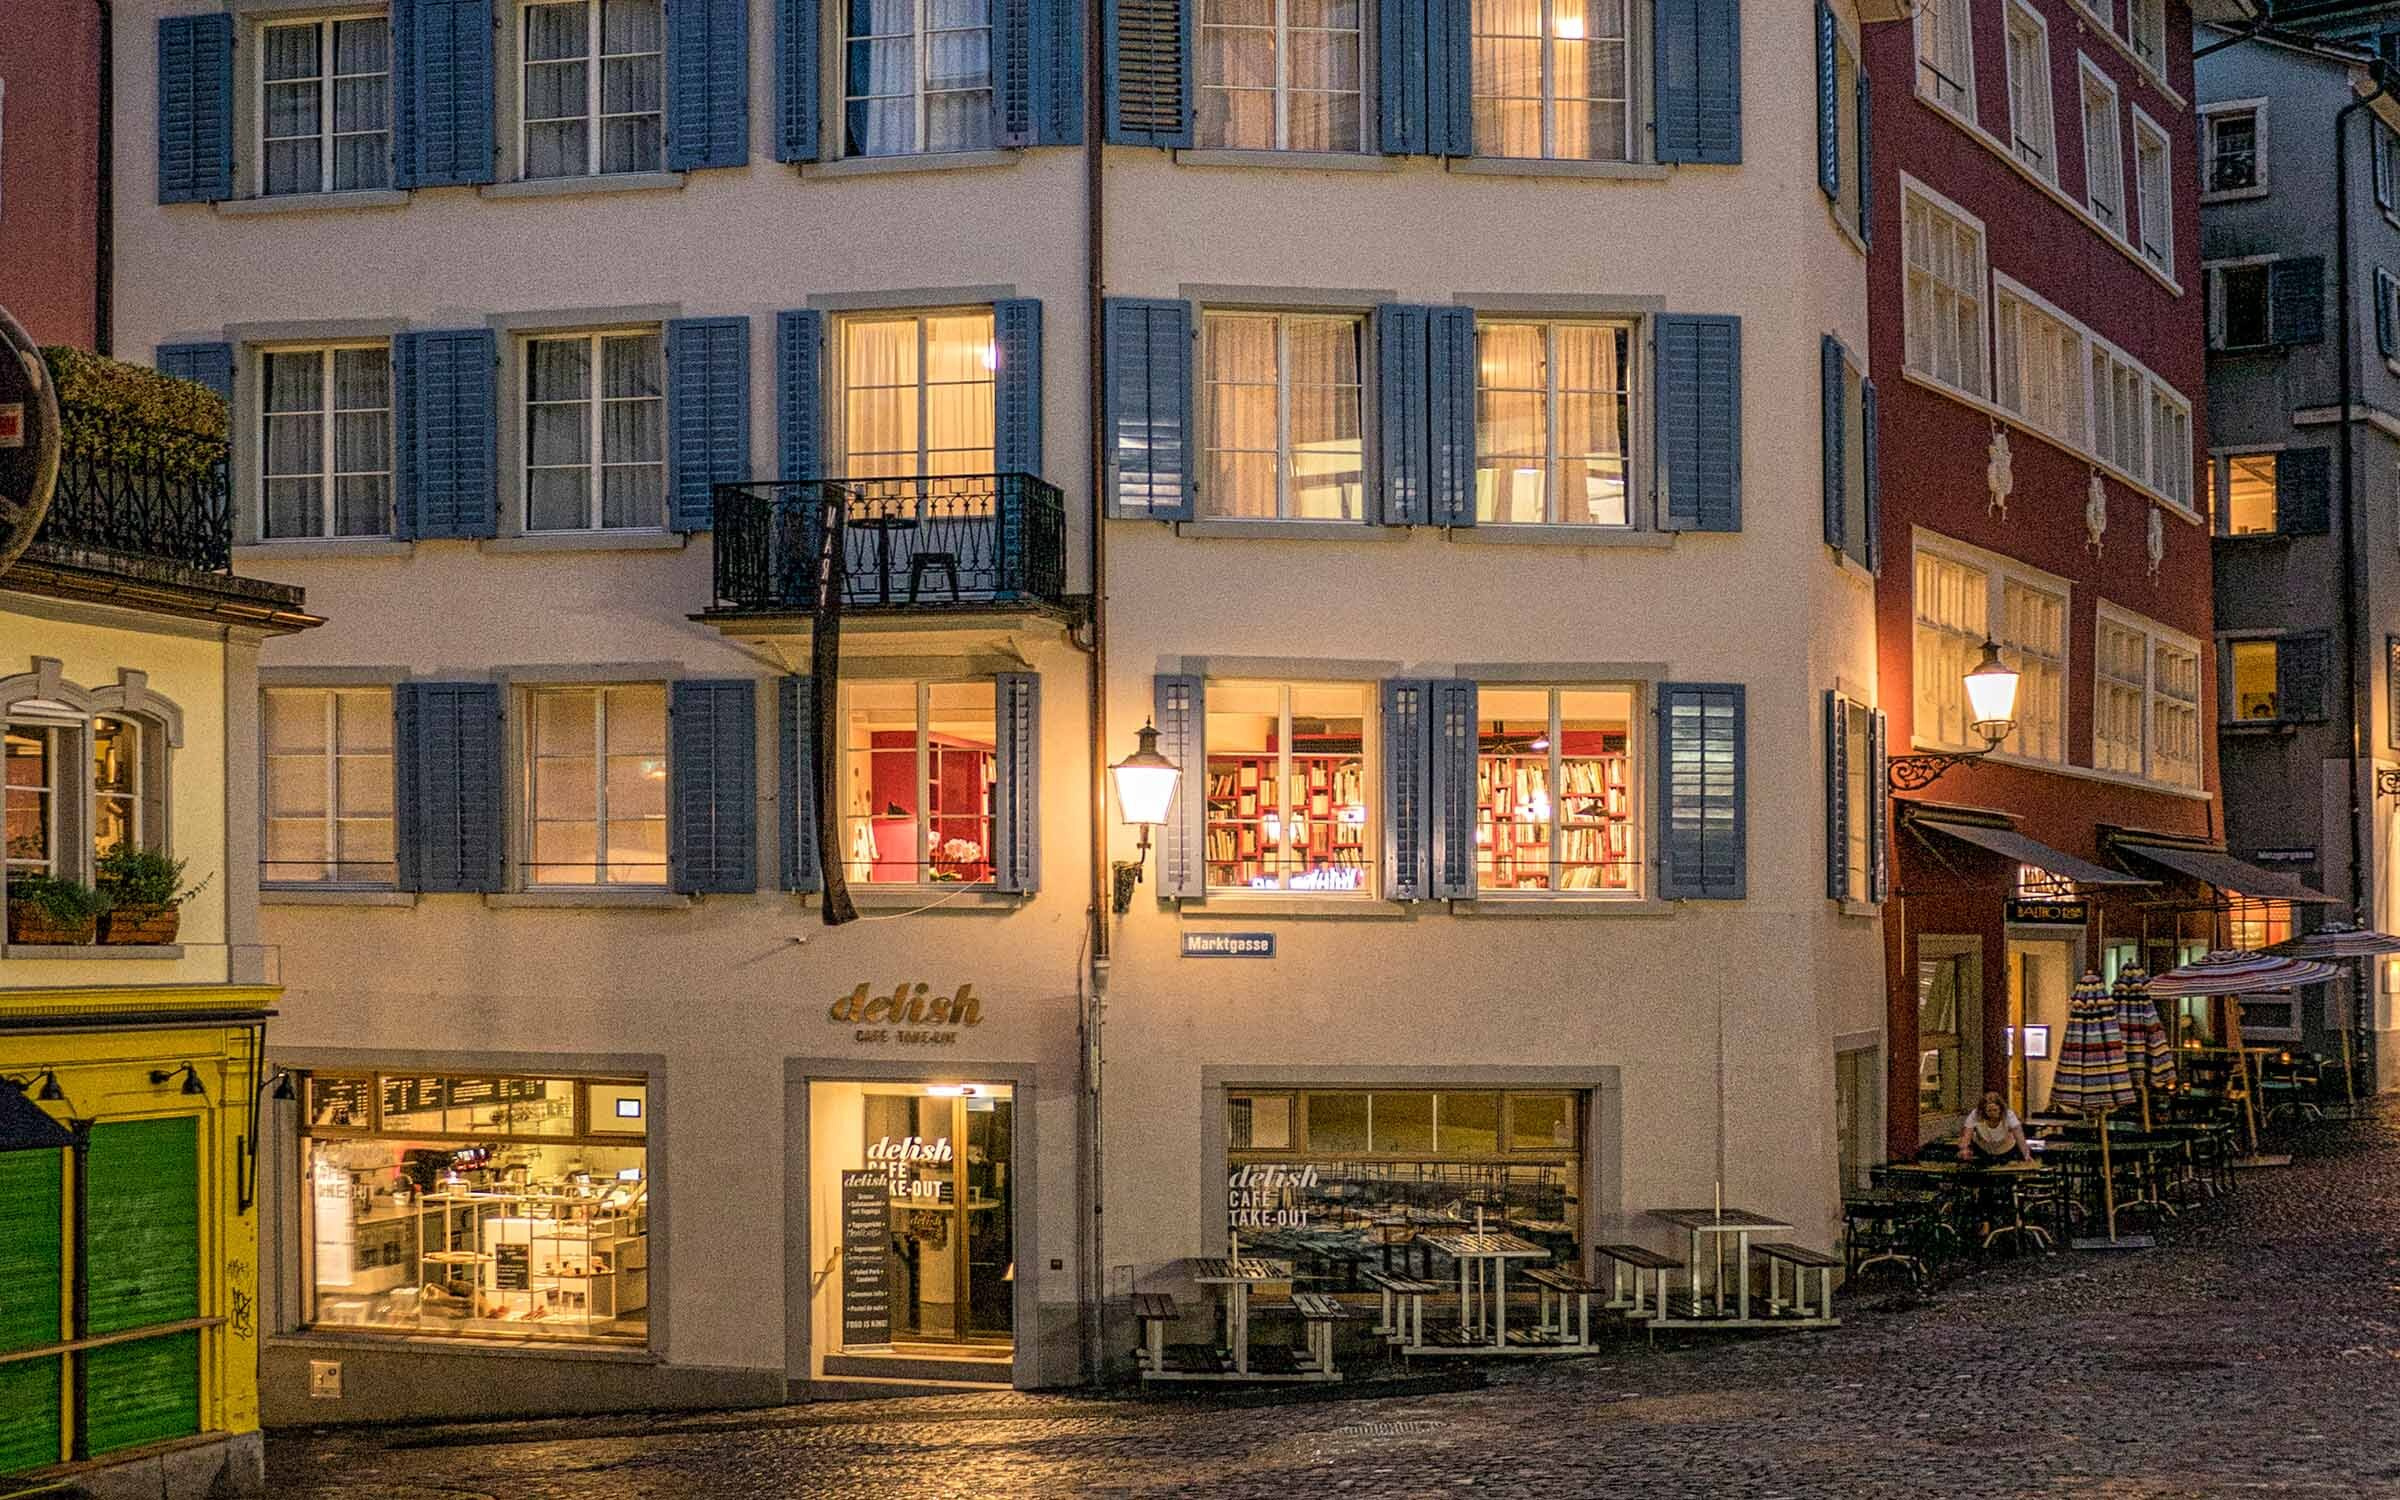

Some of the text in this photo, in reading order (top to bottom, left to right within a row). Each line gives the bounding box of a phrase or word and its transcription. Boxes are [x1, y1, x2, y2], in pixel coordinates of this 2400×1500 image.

[1188, 936, 1269, 953] Marktgasse
[831, 982, 985, 1026] delish
[867, 1136, 953, 1163] delish
[844, 1173, 887, 1187] delish
[1229, 1164, 1318, 1188] delish
[889, 1180, 943, 1197] KE-OUT
[1229, 1209, 1309, 1227] TAKE-OUT
